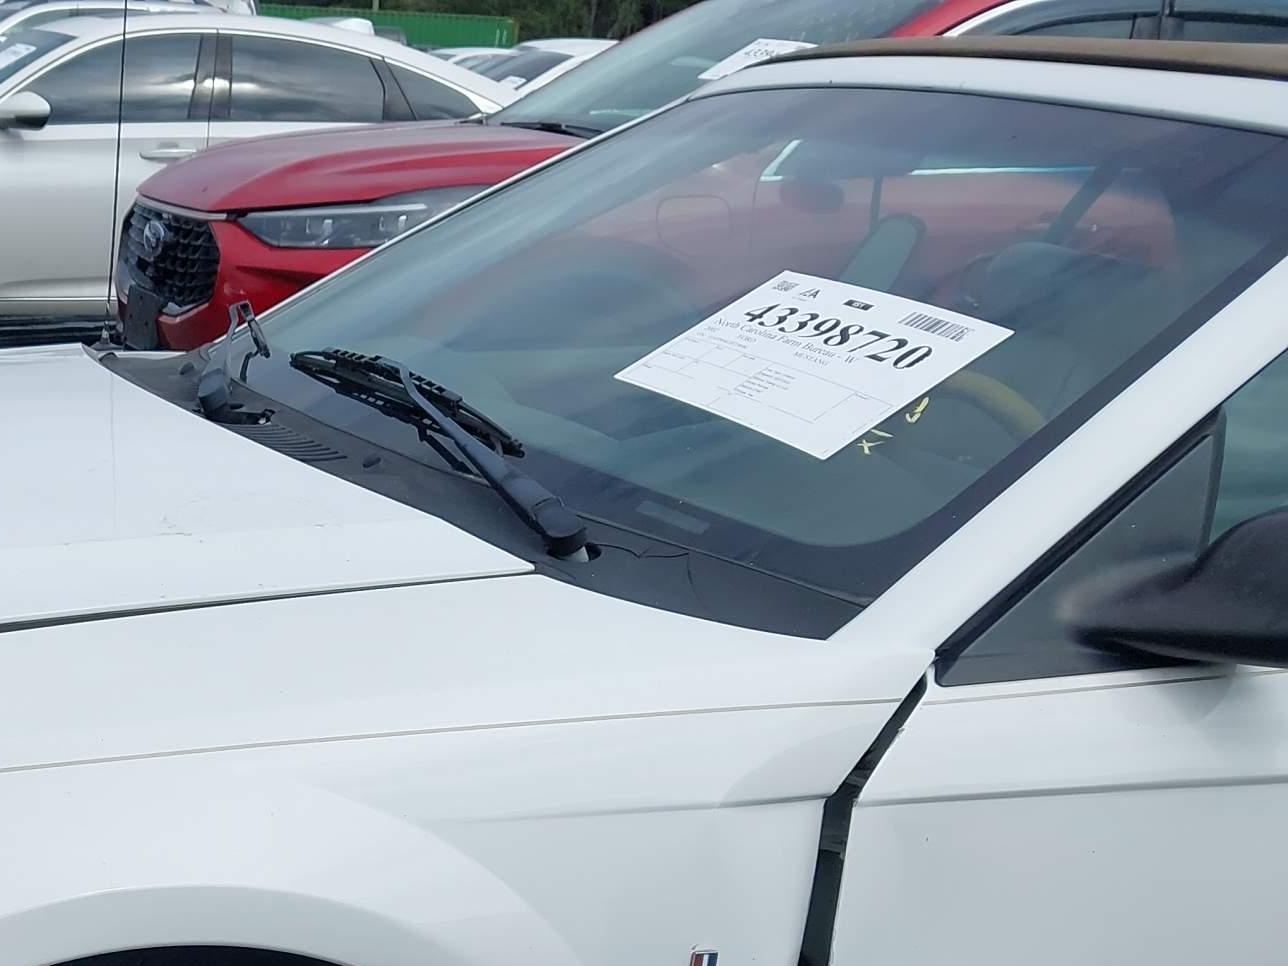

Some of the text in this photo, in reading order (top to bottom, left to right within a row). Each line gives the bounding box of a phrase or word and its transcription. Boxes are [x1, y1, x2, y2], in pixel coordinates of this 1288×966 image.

[740, 322, 777, 340] Carolina
[777, 334, 802, 348] Farm
[802, 341, 836, 359] Bureau
[743, 303, 933, 370] 43398720
